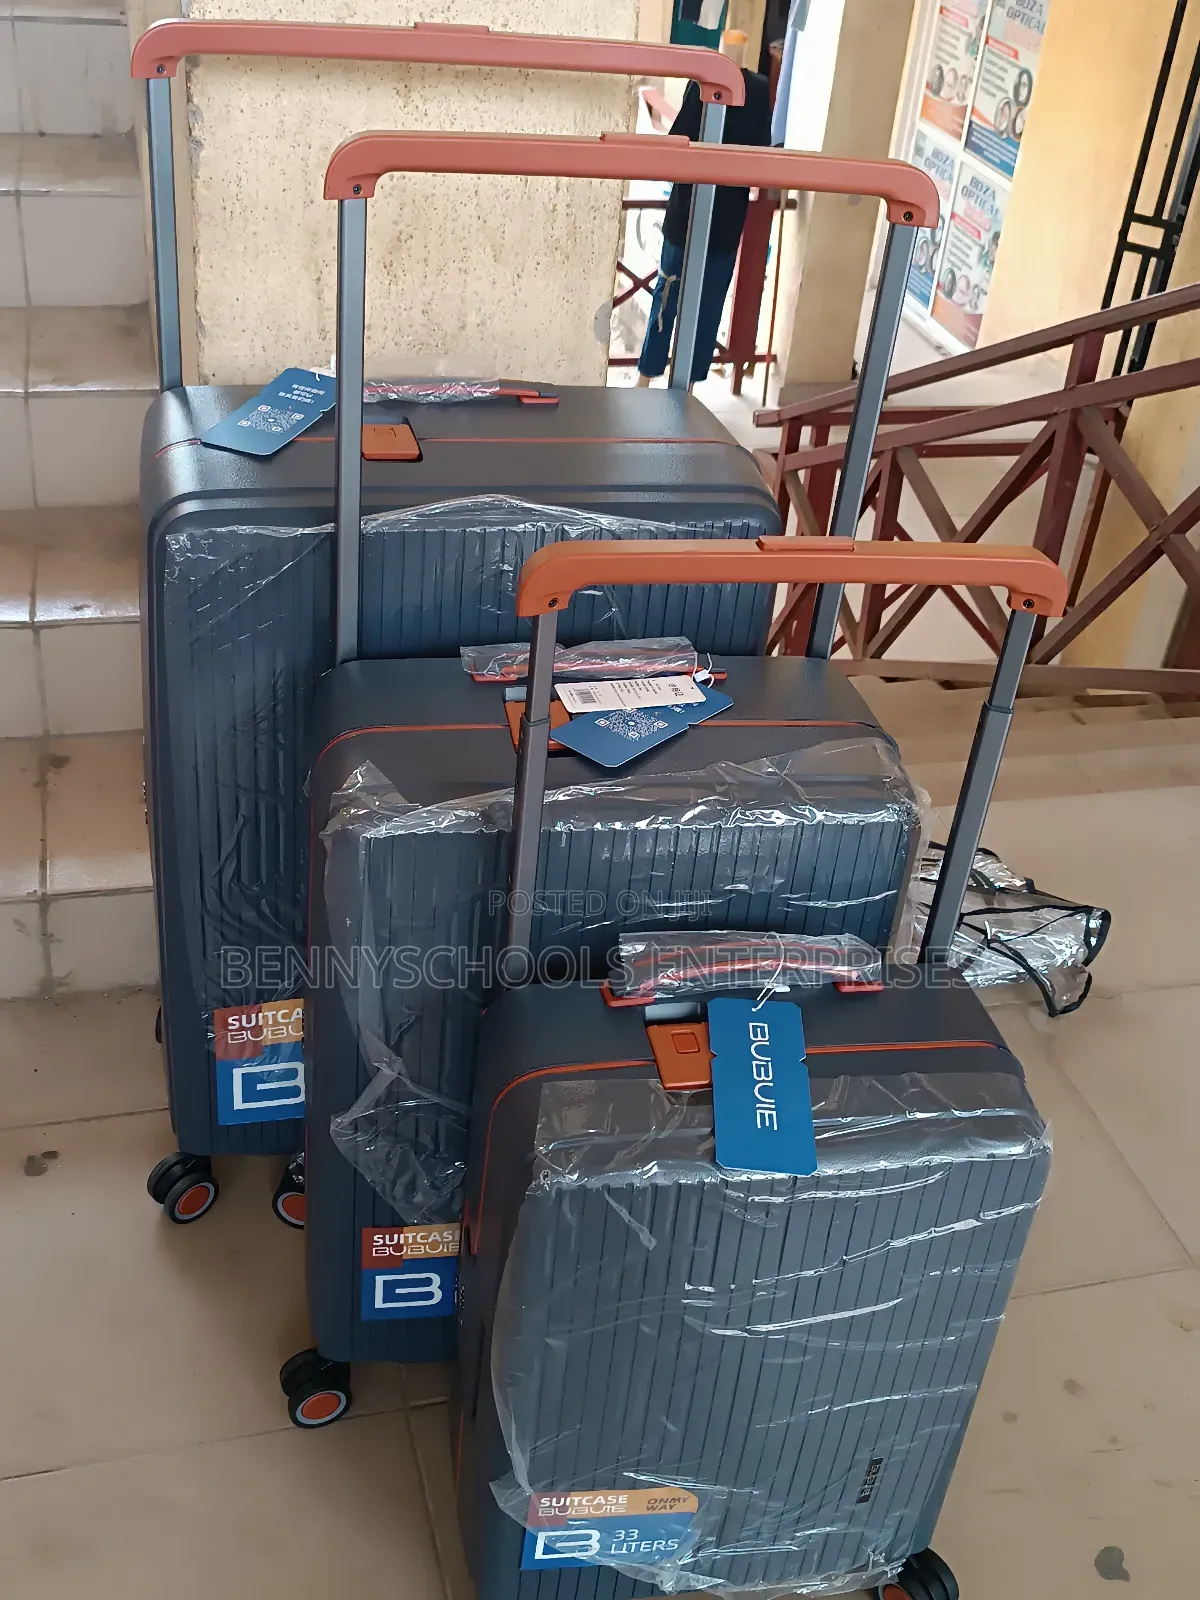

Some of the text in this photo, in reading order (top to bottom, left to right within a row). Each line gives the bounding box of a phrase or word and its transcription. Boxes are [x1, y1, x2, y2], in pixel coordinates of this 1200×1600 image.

[227, 1007, 303, 1030] SUITCA
[227, 1024, 303, 1044] BUBU
[748, 1022, 778, 1131] BUBUIE
[539, 1494, 628, 1507] SUITCASE
[645, 1503, 676, 1512] WAY
[612, 1528, 639, 1542] 33
[610, 1538, 680, 1555] LITERS
